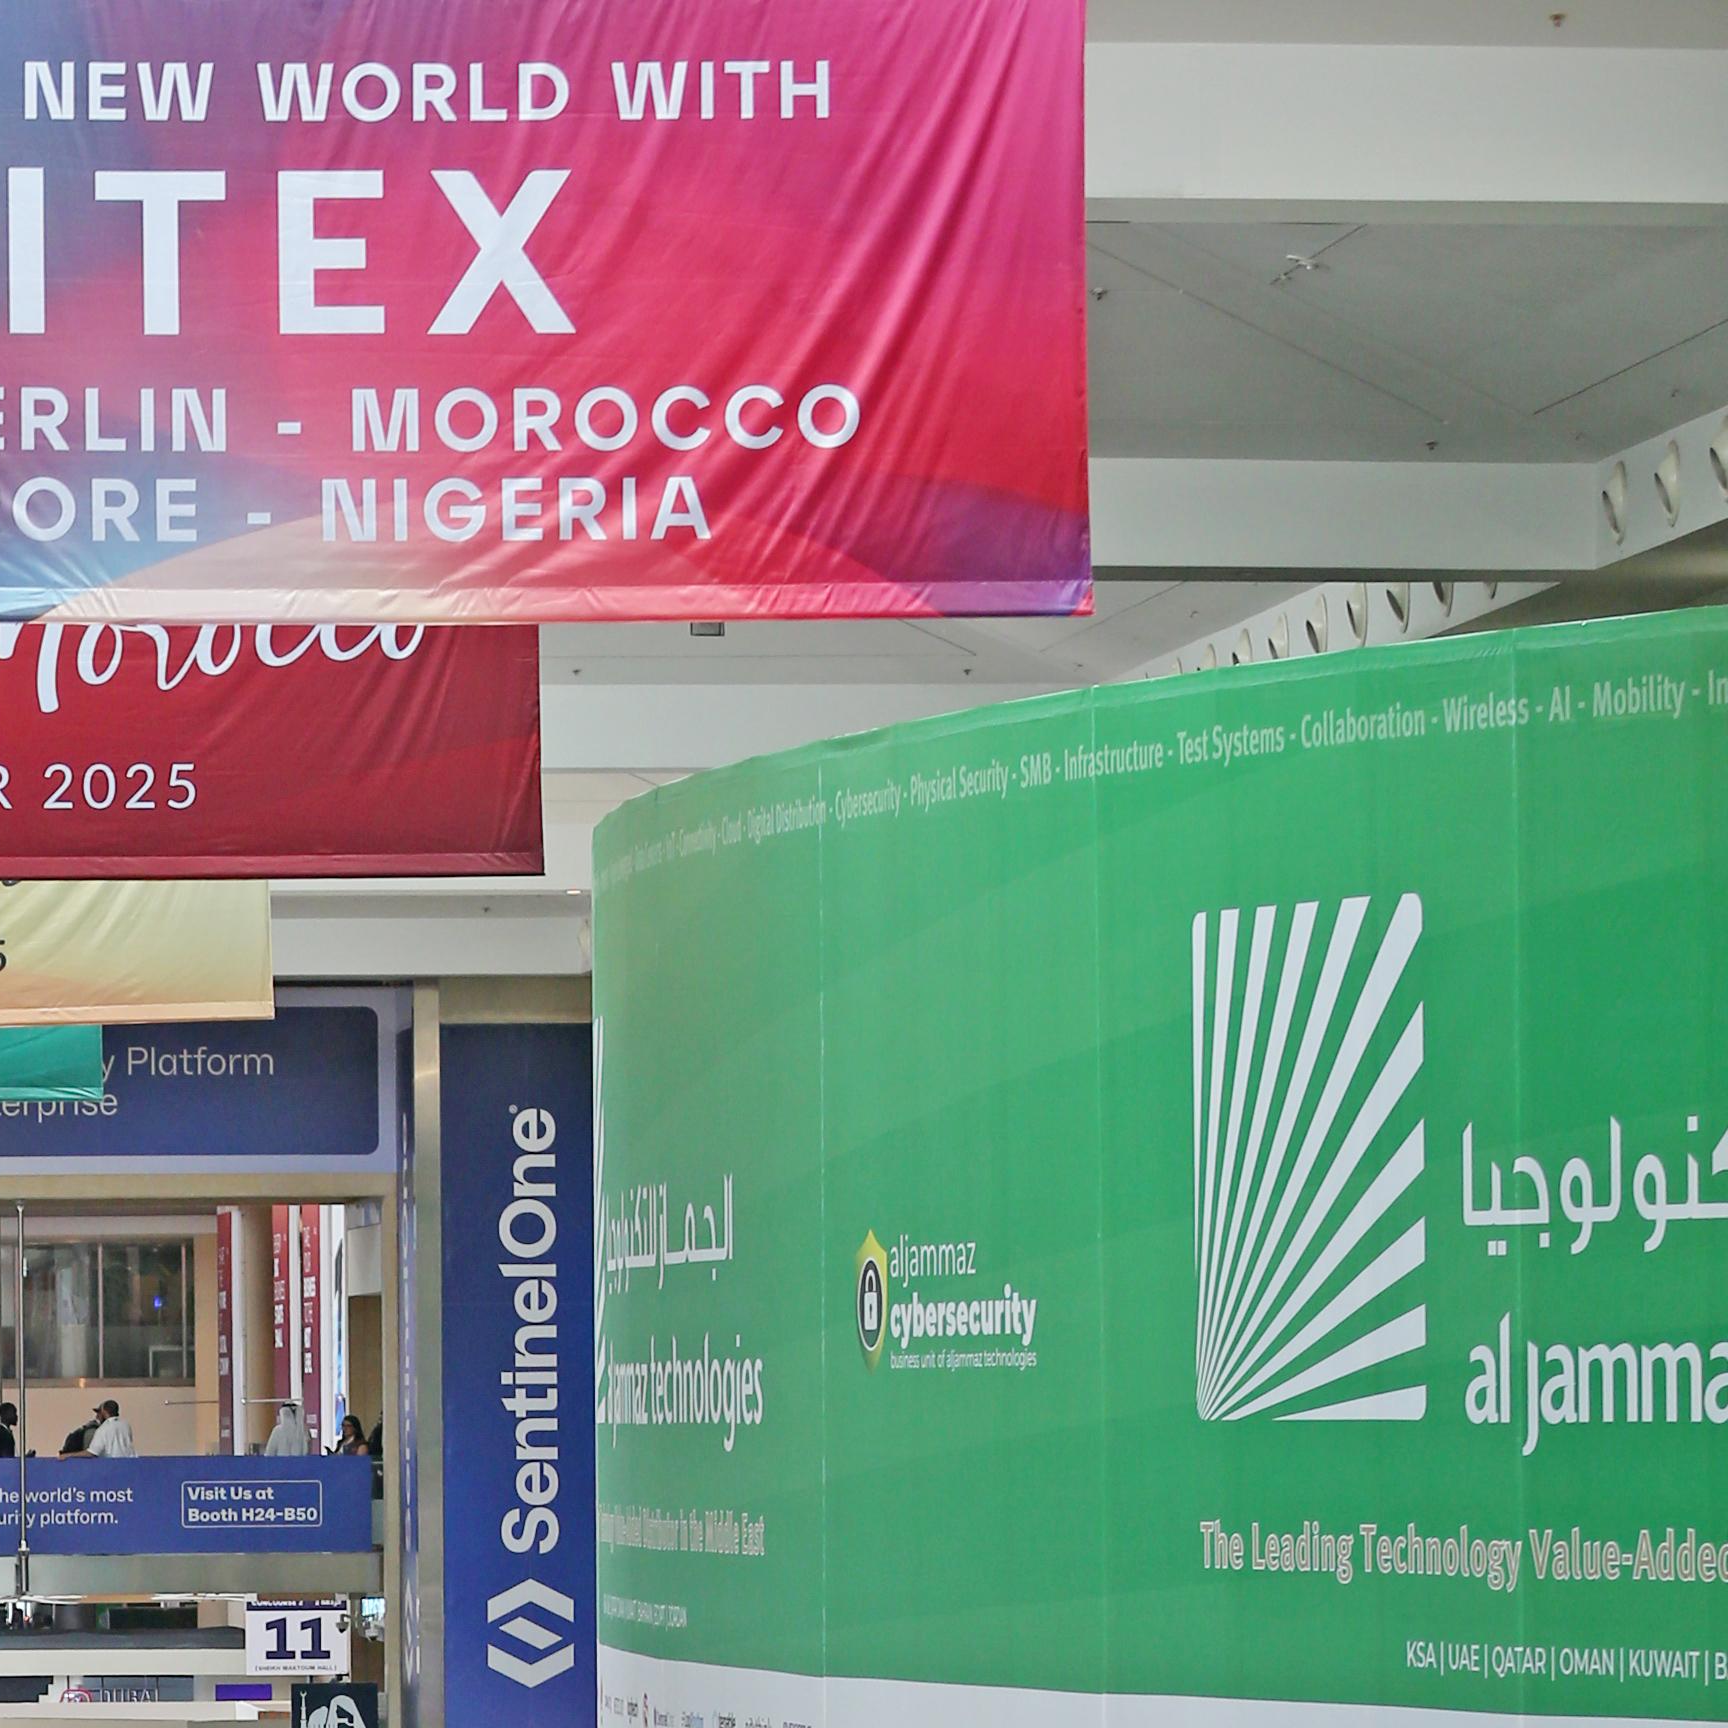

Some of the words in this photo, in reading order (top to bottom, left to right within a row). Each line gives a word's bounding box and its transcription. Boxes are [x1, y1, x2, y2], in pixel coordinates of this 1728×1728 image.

[22, 59, 213, 122] NEW
[255, 60, 570, 122] WORLD
[612, 58, 832, 119] WITH
[352, 384, 864, 454] MOROCCO
[318, 476, 713, 546] NIGERIA
[1063, 735, 1165, 782] Infrastructure
[1176, 730, 1209, 766] Test
[1211, 722, 1285, 767] Systems
[1300, 700, 1426, 750] Collaboration
[1442, 690, 1529, 734] Wireless
[1548, 685, 1571, 722] AI
[1592, 674, 1686, 719] Mobility
[42, 761, 200, 812] 2025
[747, 807, 773, 845] Digital
[774, 794, 828, 836] Distribution
[834, 785, 901, 832] Cybersecurity
[909, 763, 958, 813] Physical
[959, 757, 1009, 799] Security
[1019, 753, 1053, 790] SMB
[126, 1044, 276, 1078] Platform
[889, 1233, 977, 1288] aljammaz
[498, 1103, 560, 1556] SentinelOne
[889, 1282, 1038, 1349] cybersecurity
[983, 1347, 1037, 1371] technologies
[650, 1331, 764, 1452] technologies
[24, 1485, 86, 1504] world's
[90, 1487, 134, 1504] most
[39, 1508, 120, 1530] platform.
[187, 1485, 227, 1501] Visit
[229, 1485, 253, 1501] Us
[254, 1485, 275, 1501] at
[187, 1507, 239, 1523] Booth
[241, 1506, 319, 1523] H24-B50
[741, 1511, 767, 1558] East
[1200, 1518, 1244, 1571] The
[1250, 1520, 1354, 1585] Leading
[1359, 1523, 1523, 1592] Technology
[265, 1616, 332, 1660] 11
[1406, 1641, 1438, 1672] KSA
[1447, 1643, 1481, 1674] UAE
[1491, 1645, 1548, 1677] QATAR
[1559, 1646, 1616, 1678] OMAN
[1628, 1648, 1701, 1680] KUWAIT
